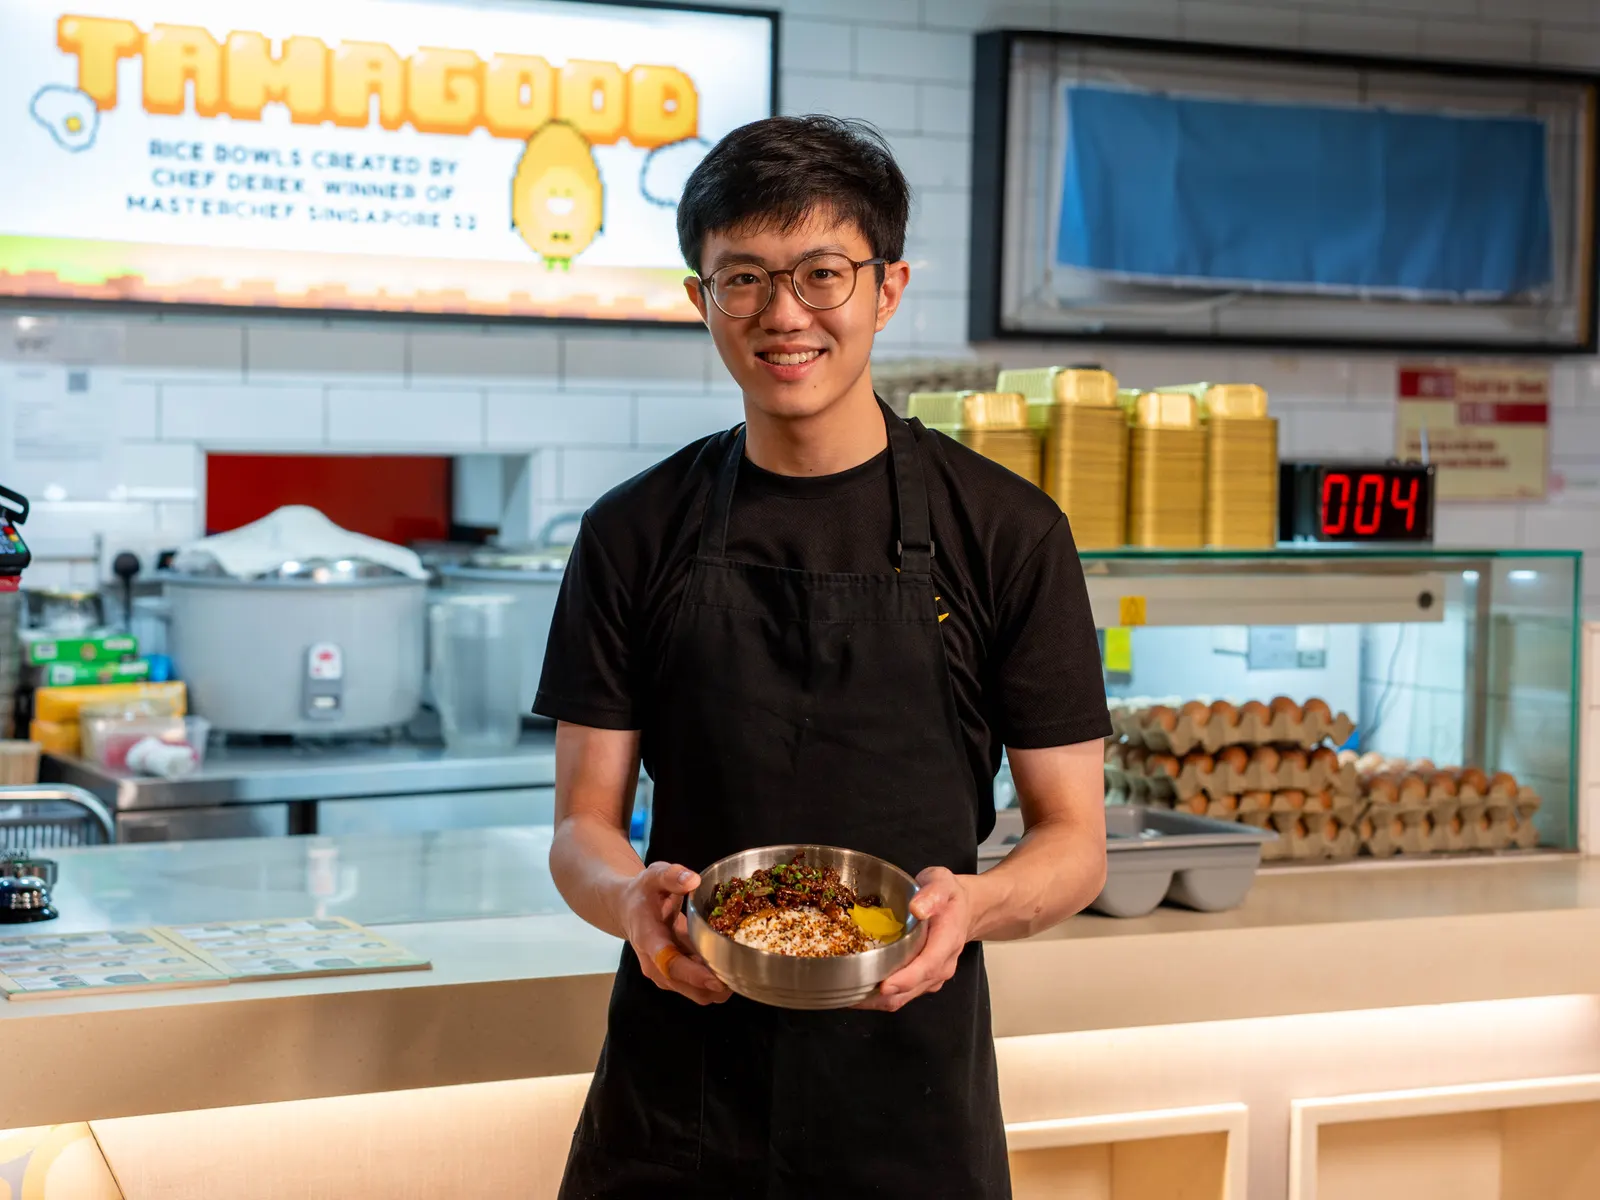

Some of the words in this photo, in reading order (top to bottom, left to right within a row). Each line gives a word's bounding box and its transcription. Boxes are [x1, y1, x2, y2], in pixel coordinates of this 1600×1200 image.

[57, 14, 699, 148] TAMAGOOD
[151, 168, 216, 188] CHEF
[425, 184, 455, 202] OF
[1321, 473, 1419, 535] 004
